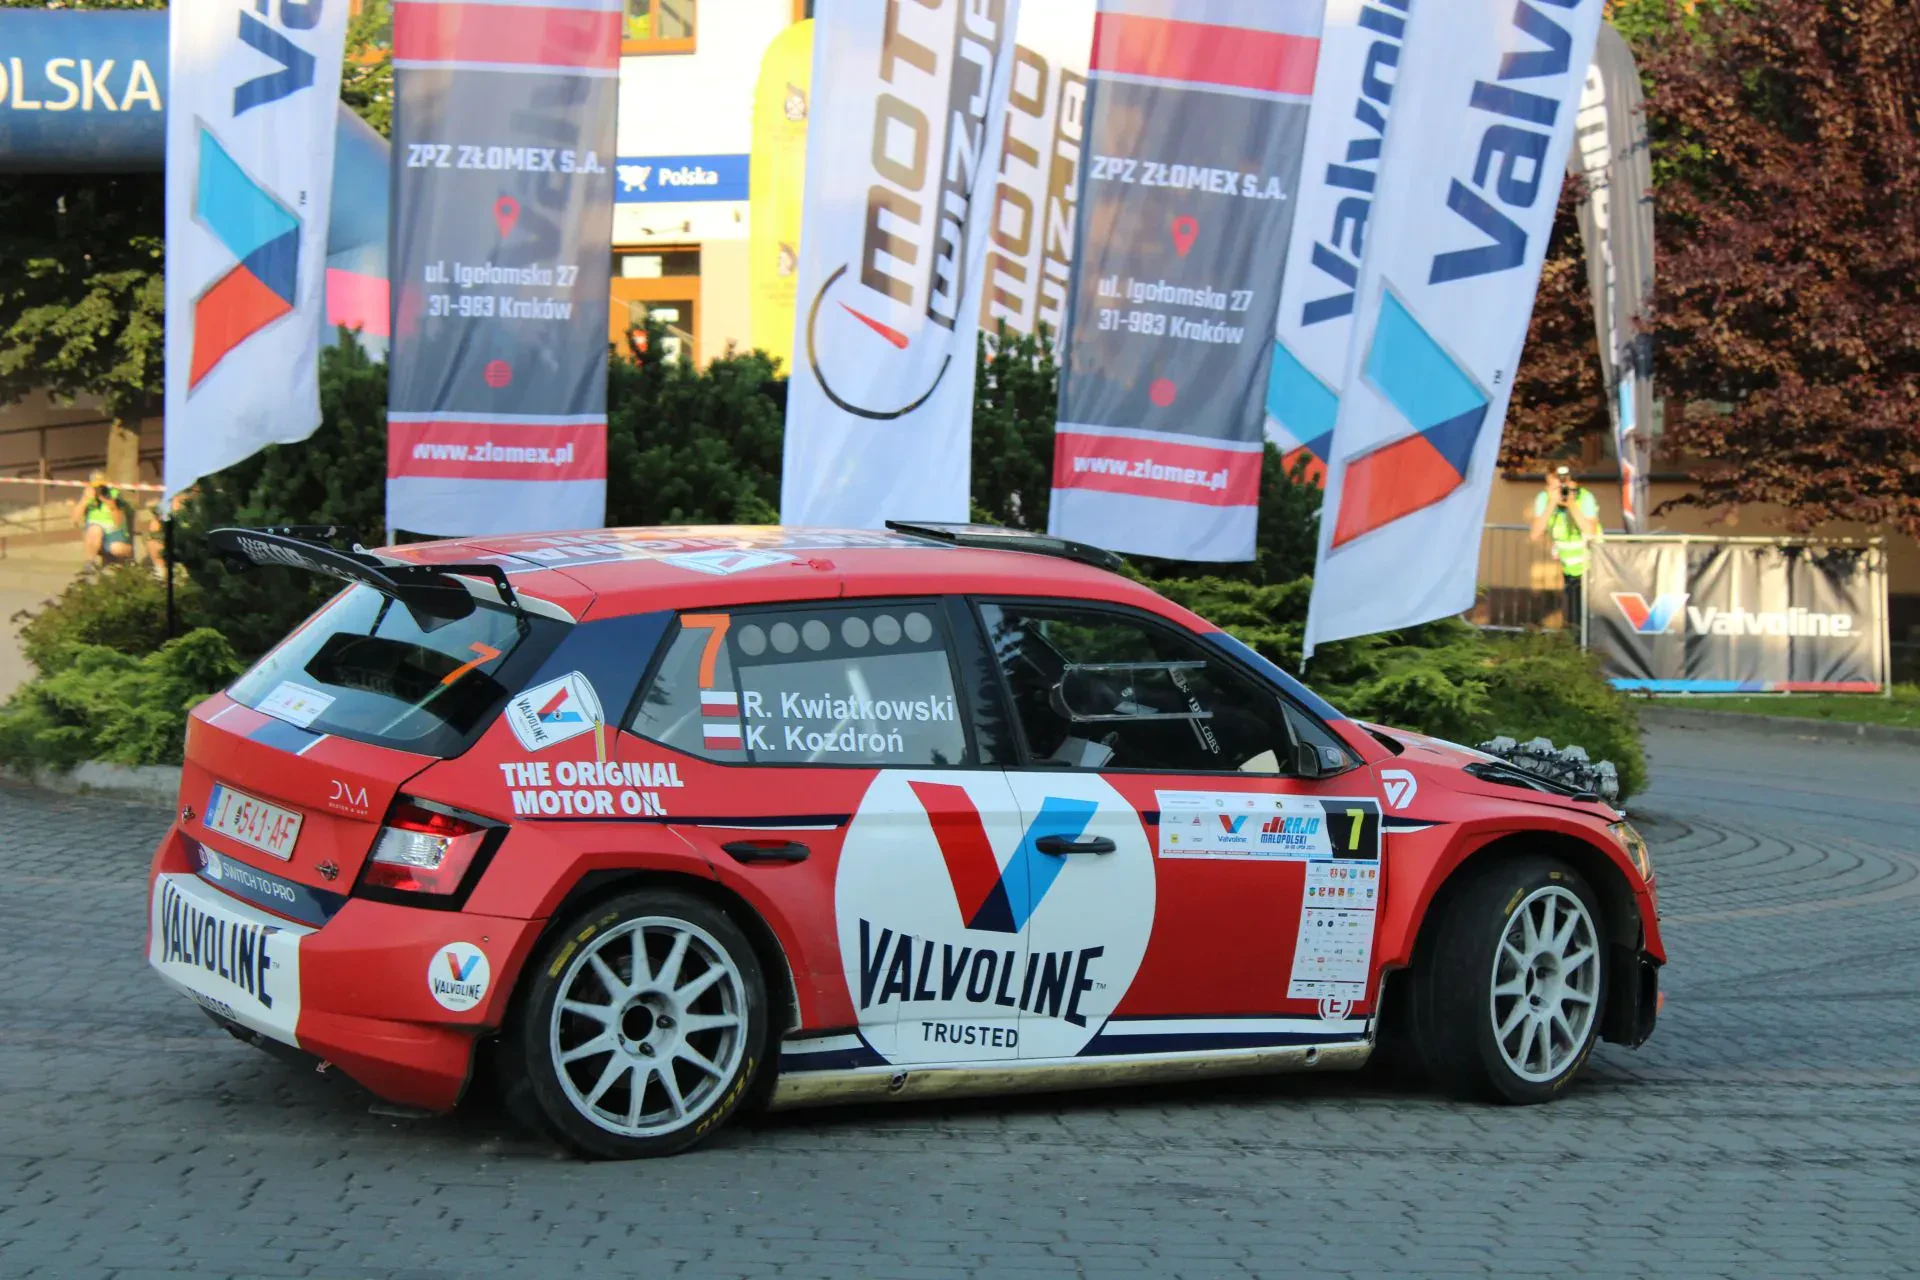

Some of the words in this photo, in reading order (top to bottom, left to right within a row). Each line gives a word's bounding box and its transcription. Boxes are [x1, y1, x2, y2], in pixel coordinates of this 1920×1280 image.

[861, 0, 945, 307] MOT
[1429, 0, 1582, 285] Valv
[407, 144, 451, 168] ZPZ
[457, 145, 556, 172] ZŁOMEX
[559, 150, 606, 174] S.A.
[659, 168, 718, 188] Polska
[1090, 156, 1137, 183] ZPZ
[1141, 161, 1238, 196] ZŁOMEX
[1242, 173, 1287, 200] S.A.
[425, 260, 450, 283] ul.
[556, 265, 579, 287] 27
[429, 294, 495, 317] 31-983
[500, 296, 573, 320] Kraków
[1098, 275, 1121, 298] ul.
[1230, 290, 1254, 311] 27
[1098, 309, 1167, 335] 31-983
[1170, 316, 1244, 344] Kraków
[1689, 606, 1854, 637] Valvoline
[440, 642, 501, 686] 7
[680, 614, 731, 688] 7
[517, 698, 548, 743] VALVOLINE
[744, 691, 772, 718] R.
[781, 692, 954, 721] Kwiatkowski
[746, 725, 775, 751] K.
[784, 725, 904, 753] Kozdroń
[499, 763, 551, 786] THE
[555, 761, 684, 787] ORIGINAL
[511, 790, 615, 815] MOTOR
[620, 791, 667, 816] OIL
[1218, 835, 1247, 843] Valvoline
[1346, 808, 1365, 850] 7
[222, 862, 257, 888] SWITCH
[258, 876, 273, 894] TO
[273, 882, 295, 903] PRO
[162, 879, 283, 1009] VALVOLINE
[859, 918, 1105, 1028] VALVOLINE
[1096, 982, 1107, 990] TM
[434, 978, 481, 1000] VALVOLINE
[921, 1022, 1018, 1048] TRUSTED
